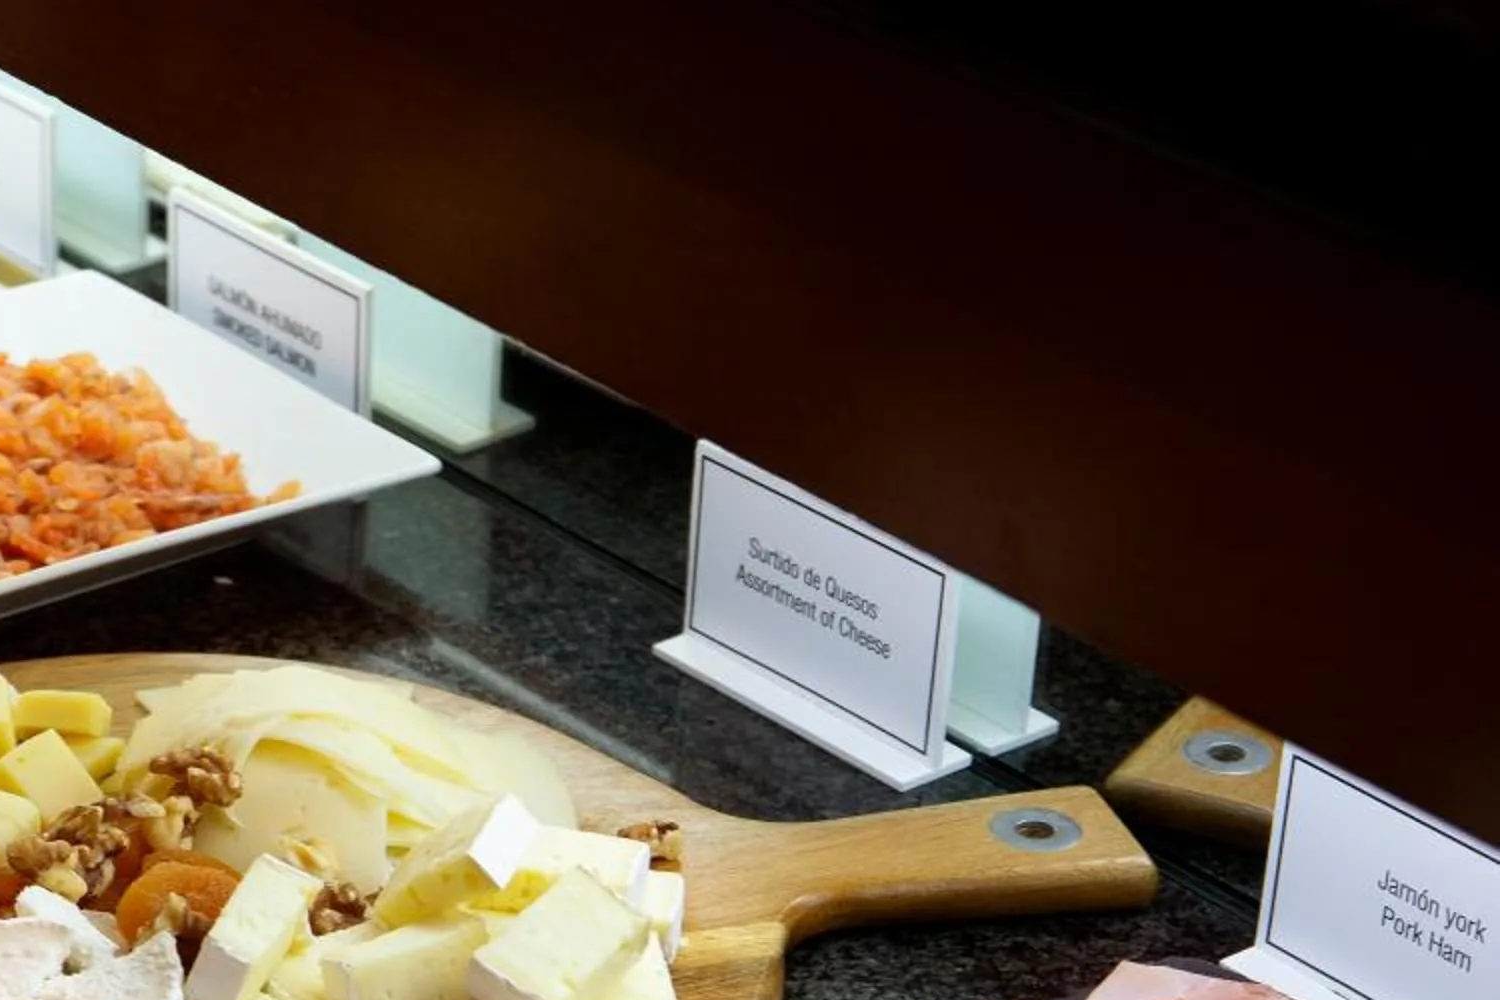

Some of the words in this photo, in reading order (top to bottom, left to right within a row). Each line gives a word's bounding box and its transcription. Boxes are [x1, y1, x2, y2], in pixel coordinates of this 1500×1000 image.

[736, 564, 817, 623] Assortment
[820, 611, 836, 631] of
[839, 616, 891, 660] Cheese
[748, 537, 799, 580] Surtido
[803, 567, 820, 591] de
[825, 575, 878, 620] Quesos
[1377, 870, 1441, 919] Jamón
[1443, 906, 1487, 944] york
[1381, 905, 1423, 947] Pork
[1428, 931, 1473, 973] Ham
